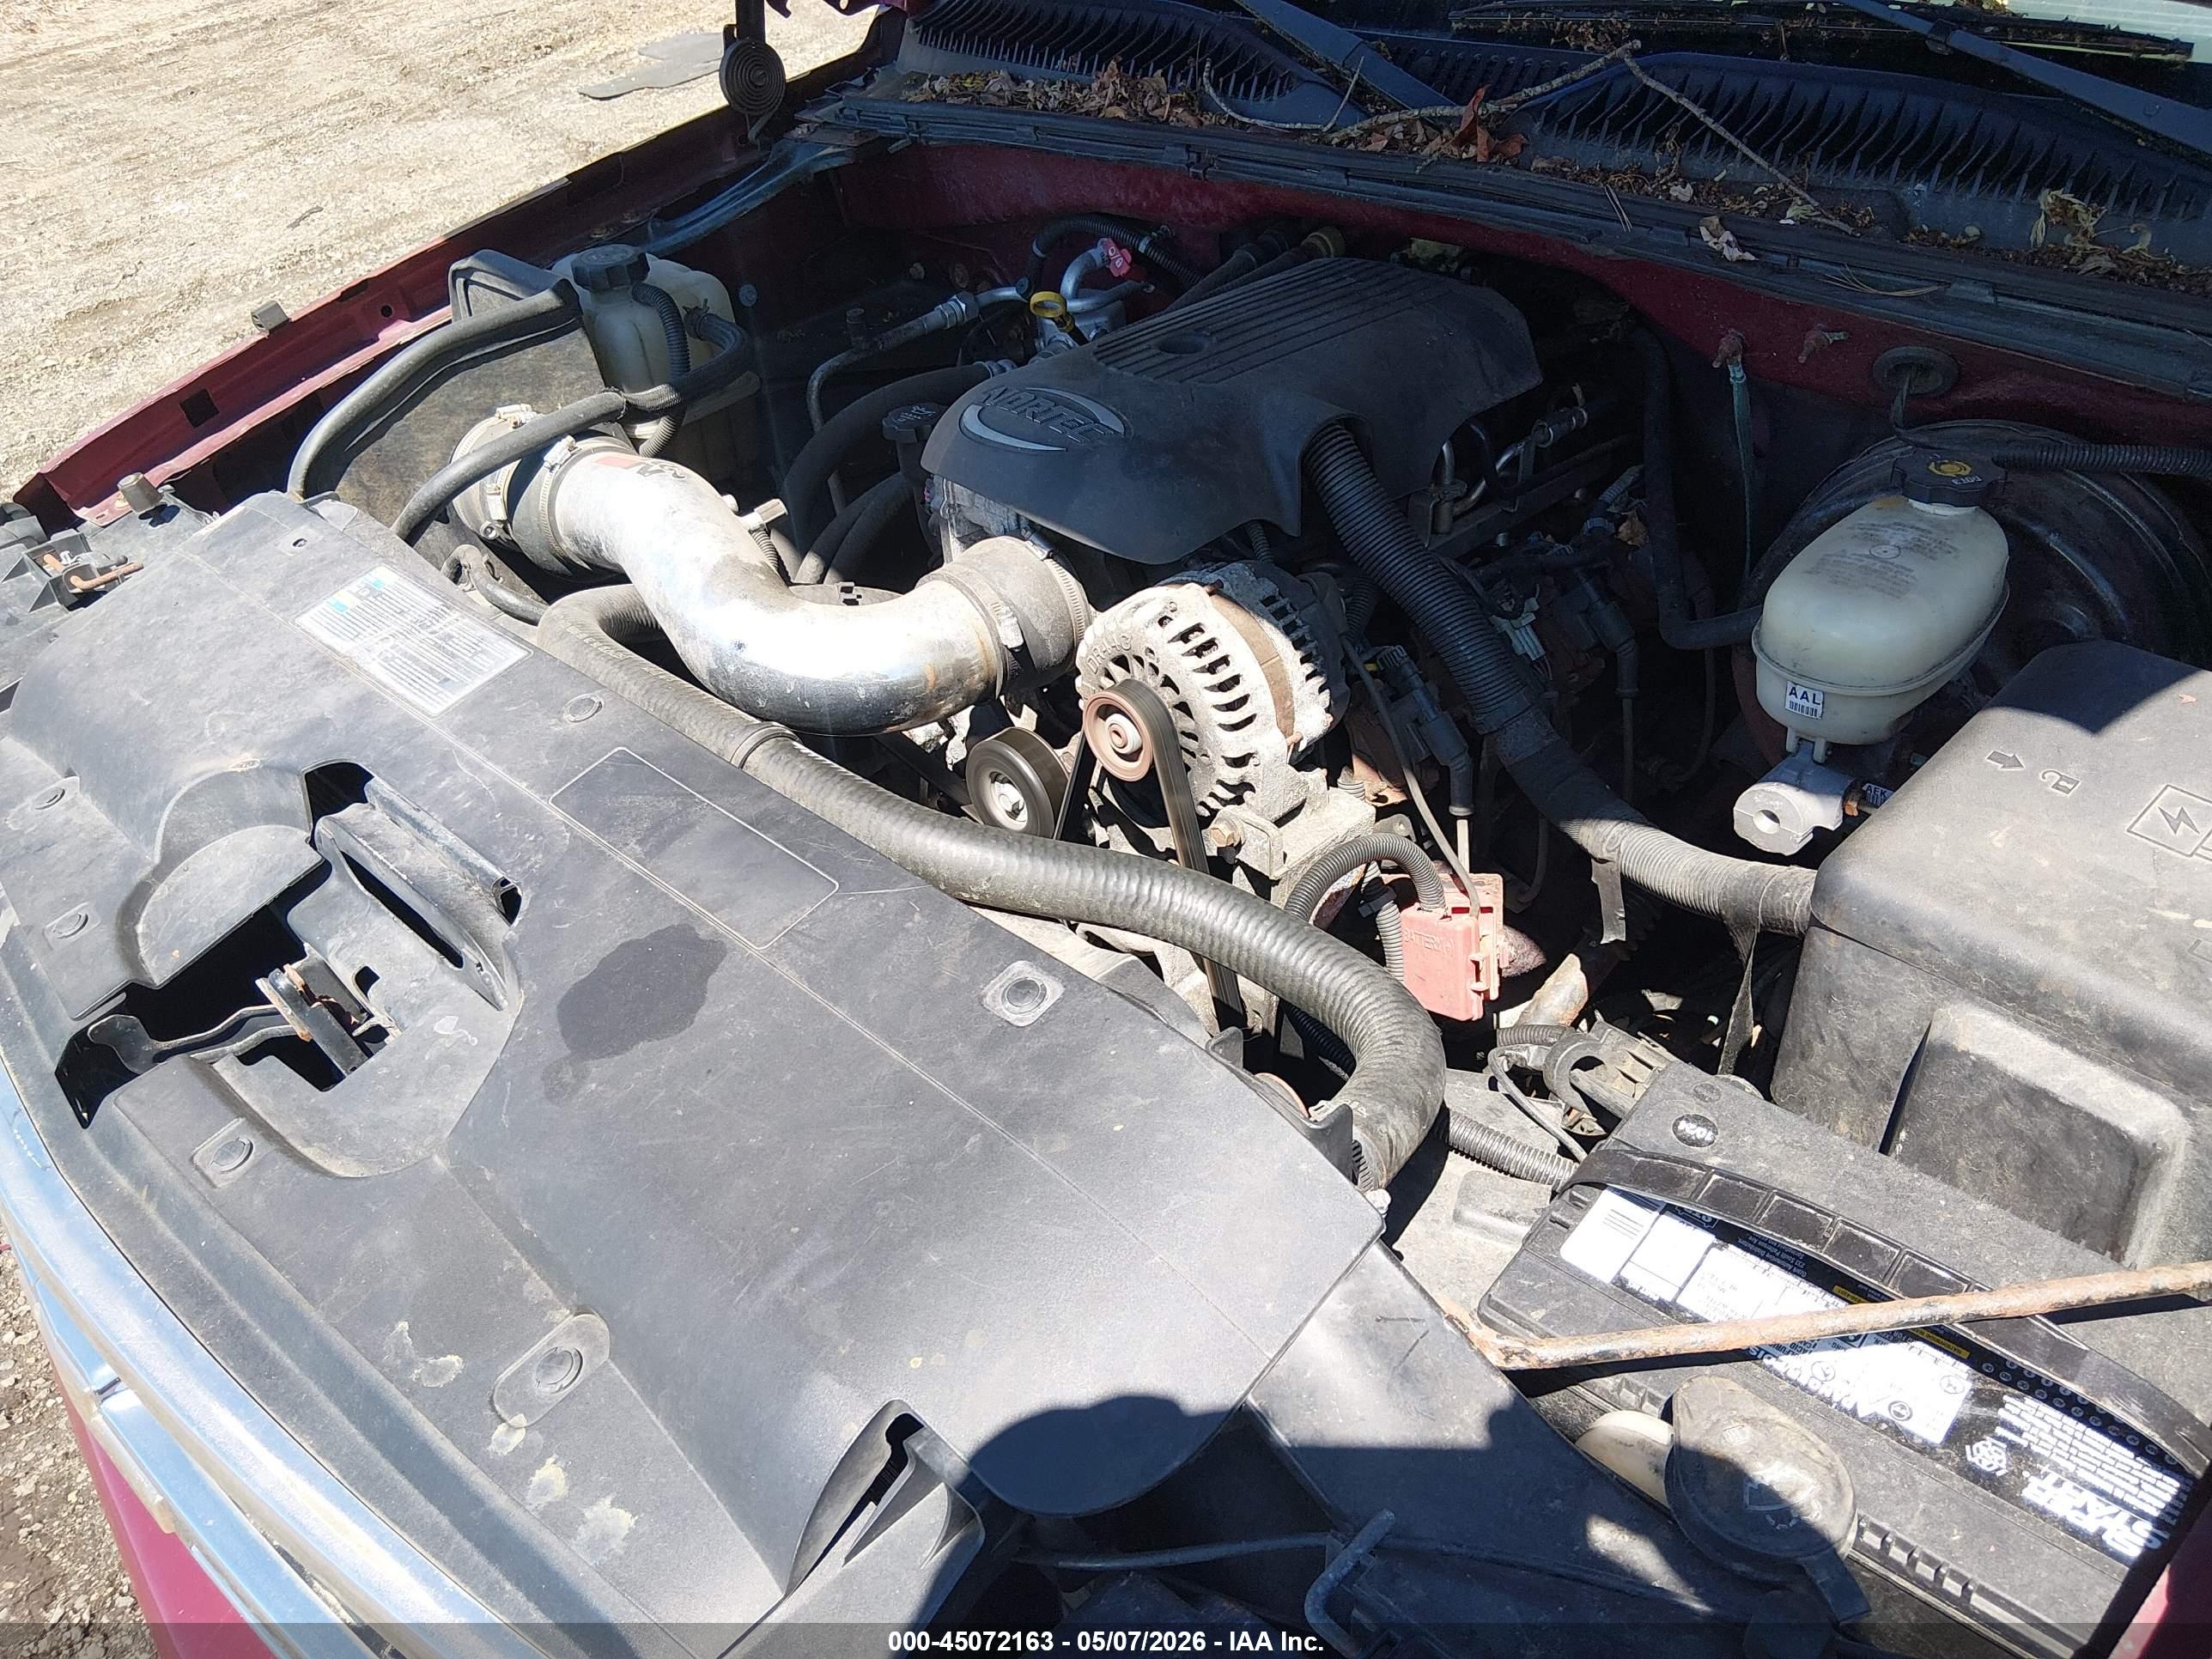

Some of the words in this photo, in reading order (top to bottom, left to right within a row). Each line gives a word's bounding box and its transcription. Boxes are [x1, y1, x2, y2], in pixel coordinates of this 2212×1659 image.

[1788, 688, 1821, 706] AAL
[1789, 1341, 1808, 1356] ACID
[2021, 1474, 2148, 1560] SUPER
[2033, 1472, 2169, 1551] START
